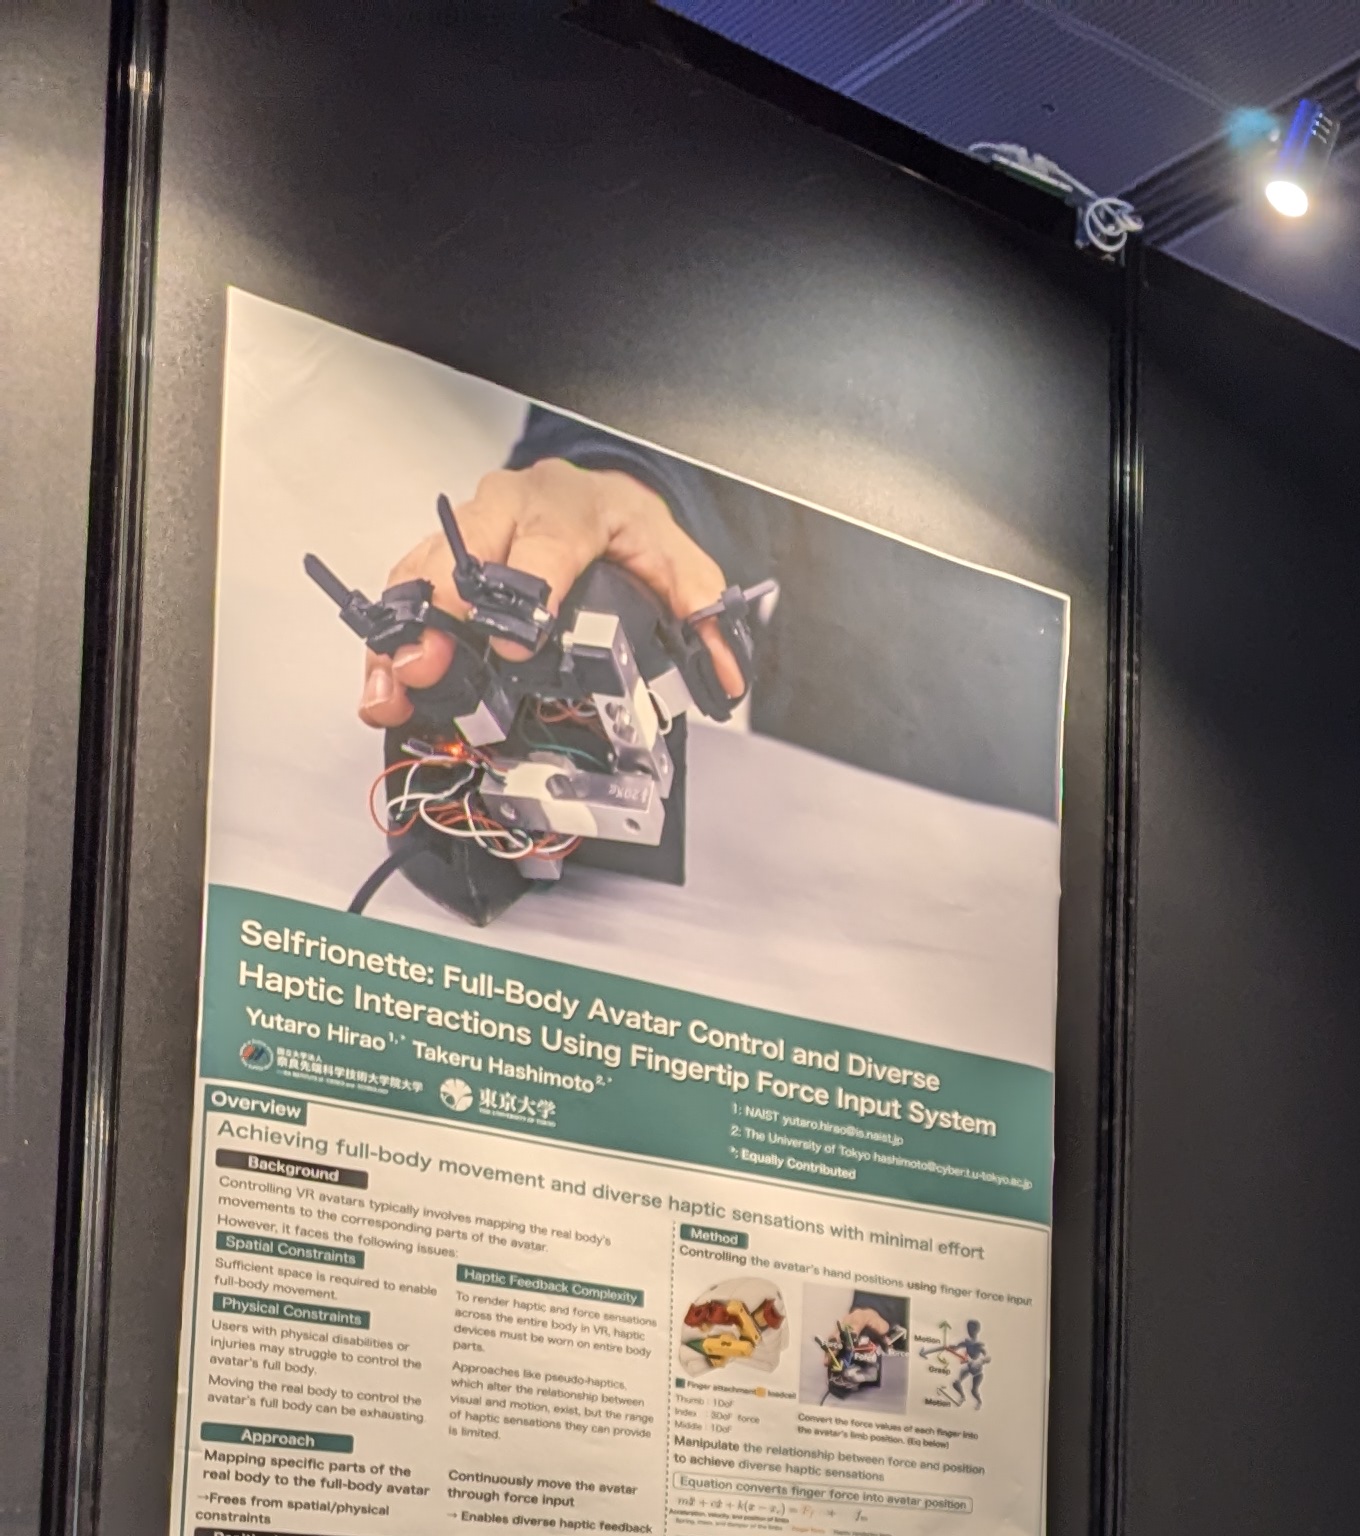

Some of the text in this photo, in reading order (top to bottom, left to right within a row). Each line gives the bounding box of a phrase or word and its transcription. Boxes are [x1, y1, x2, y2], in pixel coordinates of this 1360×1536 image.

[240, 919, 940, 1092] Selfrionette: Full-Body Avatar Control and Diverse
[244, 1005, 322, 1039] Yutaro
[239, 959, 997, 1137] Haptic Interactions Using Fingertip Force Input System
[411, 1039, 483, 1072] Takeru
[210, 1090, 302, 1119] Overview
[478, 1088, 557, 1119] 東京大学
[247, 1154, 341, 1183] Background
[217, 1119, 985, 1261] Achieving full-body movement and diverse haptic sensations with minimal effort
[217, 1195, 296, 1216] movements
[298, 1206, 314, 1218] to
[315, 1208, 338, 1222] the
[340, 1214, 433, 1238] corresponding
[434, 1227, 469, 1241] parts
[470, 1231, 485, 1243] of
[487, 1234, 508, 1247] the
[218, 1174, 612, 1248] Controlling VR avatars typically involves mapping the real body's
[225, 1234, 357, 1265] Spatial Constraints
[281, 1223, 292, 1235] it
[294, 1224, 330, 1241] faces
[332, 1231, 354, 1244] the
[357, 1233, 414, 1255] following
[689, 1227, 739, 1246] Method
[678, 1244, 1033, 1307] Controlling the avatar's hand positions using finger force input
[221, 1296, 363, 1326] Physical Constraints
[240, 1428, 316, 1447] Approach
[203, 1448, 412, 1478] Mapping specific parts of the
[202, 1468, 431, 1496] real body to the full-body avatar
[446, 1487, 576, 1508] through force input
[447, 1469, 639, 1495] Continuously move the avatar
[679, 1475, 967, 1514] Equation converts finger force into avatar position
